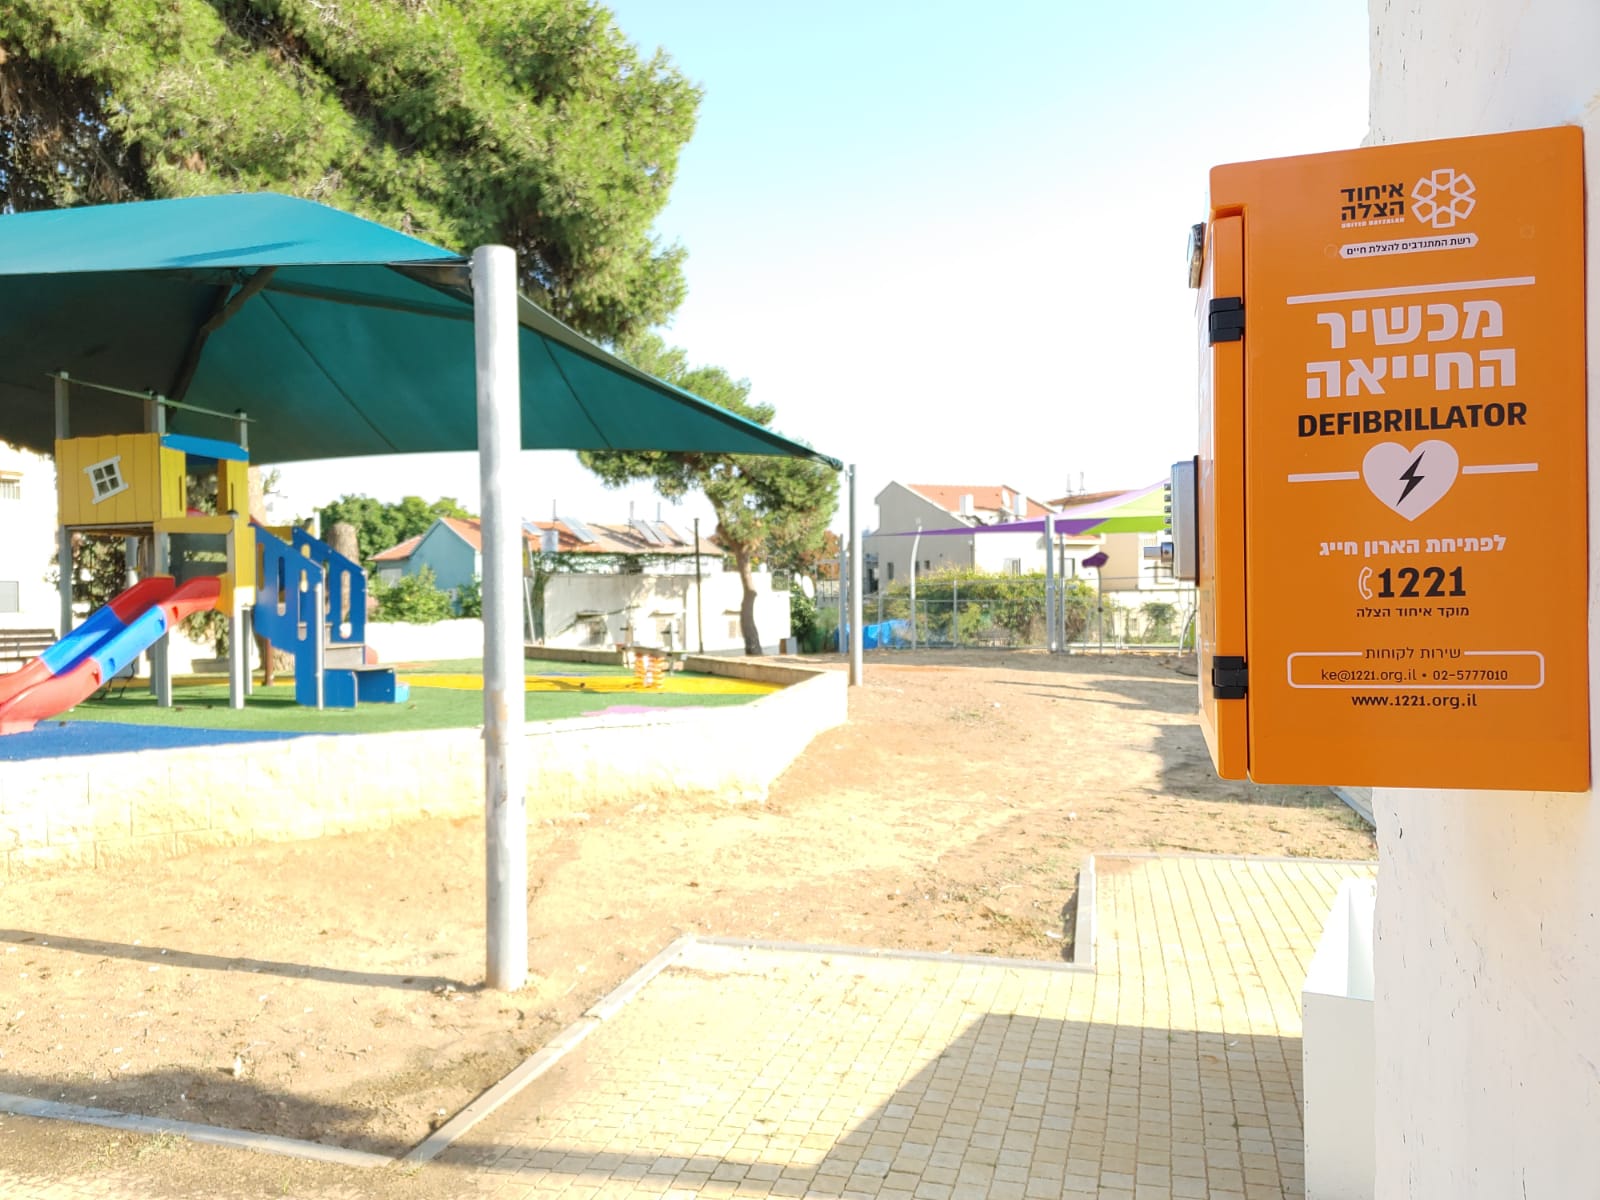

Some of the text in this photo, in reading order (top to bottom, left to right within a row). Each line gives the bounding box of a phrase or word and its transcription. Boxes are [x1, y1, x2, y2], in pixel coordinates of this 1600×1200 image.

[1340, 183, 1404, 203] איחוד
[1341, 201, 1405, 221] הצלה
[1346, 236, 1471, 255] רשת המתנדבים להצלת חיים
[1317, 300, 1503, 349] מכשיר
[1306, 348, 1516, 399] החייאה
[1298, 402, 1527, 437] DEFIBRILLATOR
[1319, 534, 1507, 558] לפתיחת הארון חייג
[1378, 566, 1466, 598] 1221
[1356, 606, 1470, 618] מוקד איחוד הצלה
[1365, 646, 1461, 660] שירות לקוחות
[1321, 668, 1508, 683] ke@1221.org.il 02-5777010
[1351, 693, 1477, 709] www.1221.org.il
